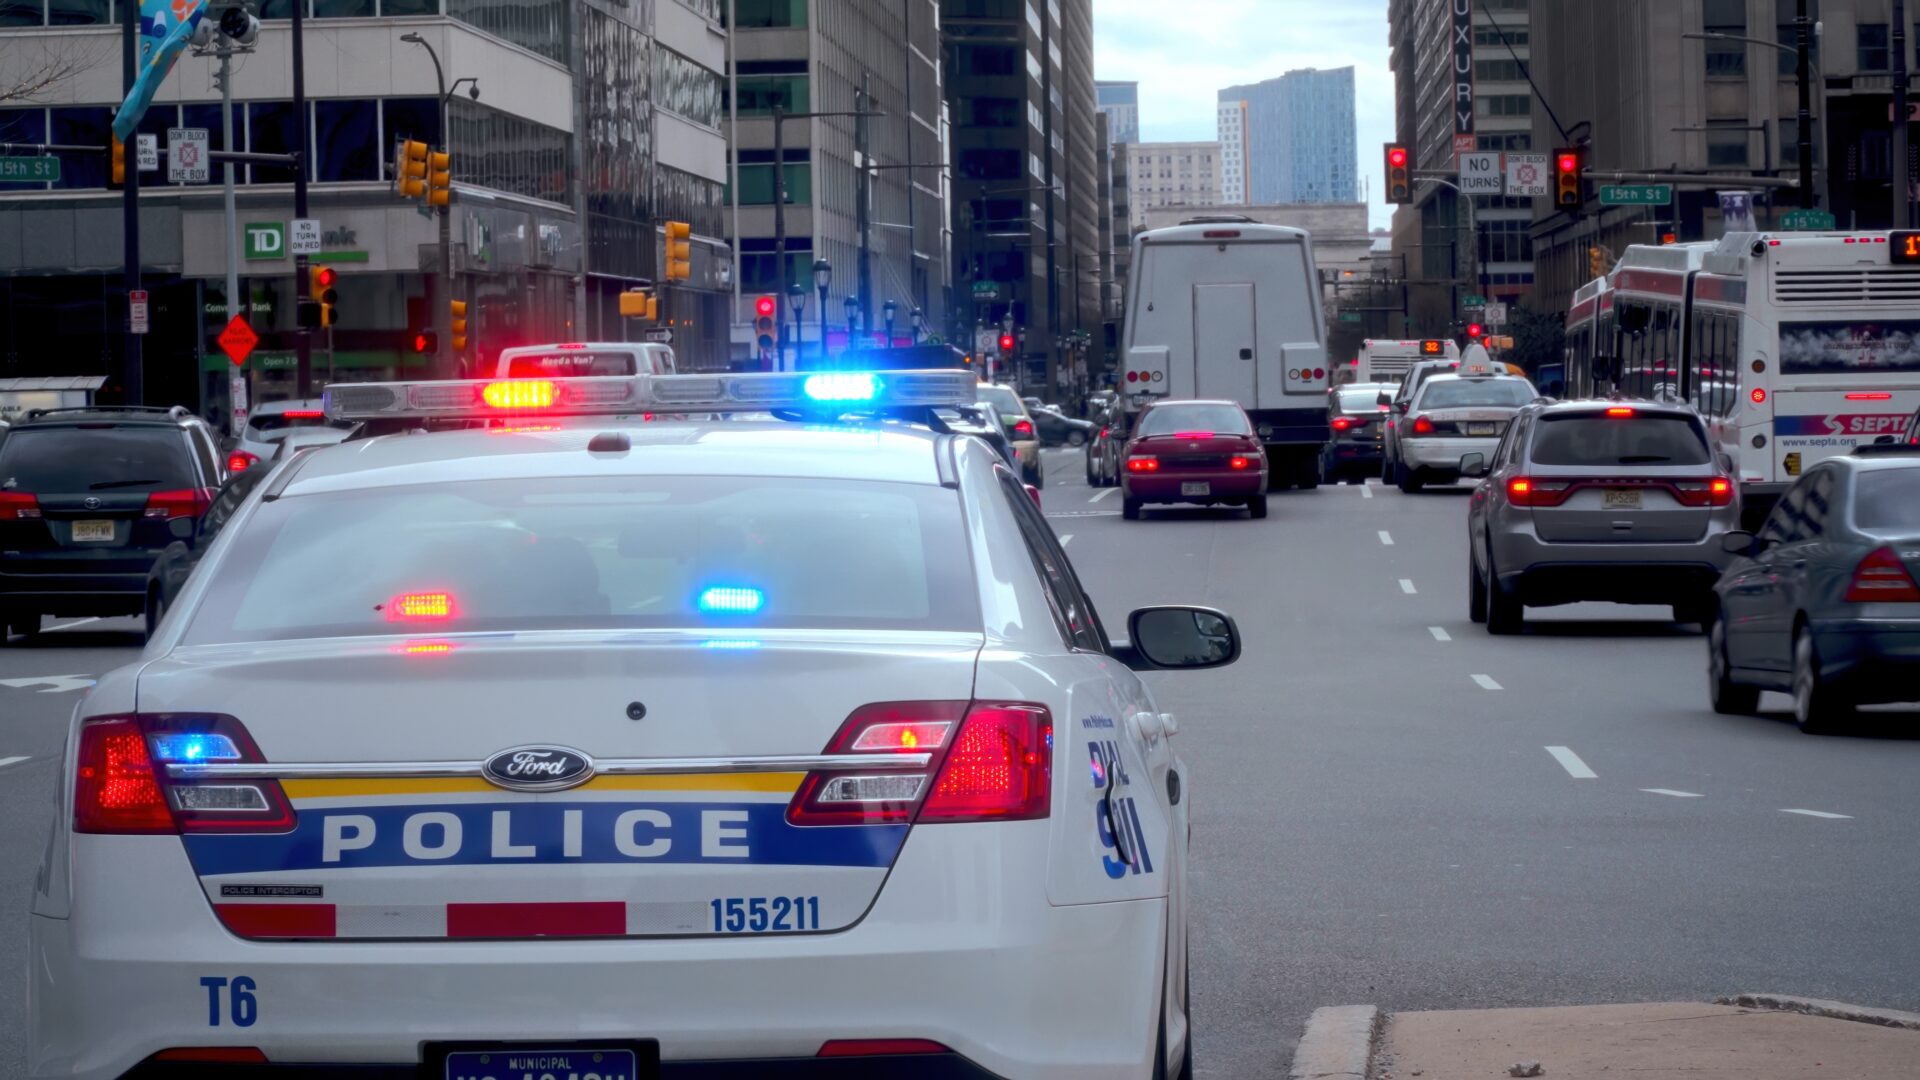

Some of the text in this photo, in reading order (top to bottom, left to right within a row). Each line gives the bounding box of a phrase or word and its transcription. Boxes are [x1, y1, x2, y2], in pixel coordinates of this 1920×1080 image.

[188, 132, 206, 140] BLOCK
[35, 162, 50, 175] St
[1469, 158, 1490, 171] NO
[172, 170, 206, 179] THE BOX
[1462, 177, 1499, 188] TURNS
[1510, 185, 1545, 195] THE BOX
[1609, 189, 1661, 199] 15th St
[300, 223, 312, 231] NO
[247, 228, 281, 252] TD
[305, 241, 320, 249] RED
[251, 302, 272, 312] Bank
[1425, 342, 1439, 352] 32
[264, 357, 284, 367] Open
[542, 357, 565, 366] Need
[573, 355, 594, 364] Van?
[1782, 437, 1857, 448] www.septa.org
[507, 751, 567, 775] Ford
[1087, 740, 1130, 788] DIAL
[322, 809, 750, 862] POLICE
[1096, 797, 1154, 879] 911
[257, 887, 320, 895] INTERCEPTOR
[710, 896, 819, 932] 155211
[201, 975, 258, 1027] T6
[509, 1056, 572, 1070] MUNICIPAL
